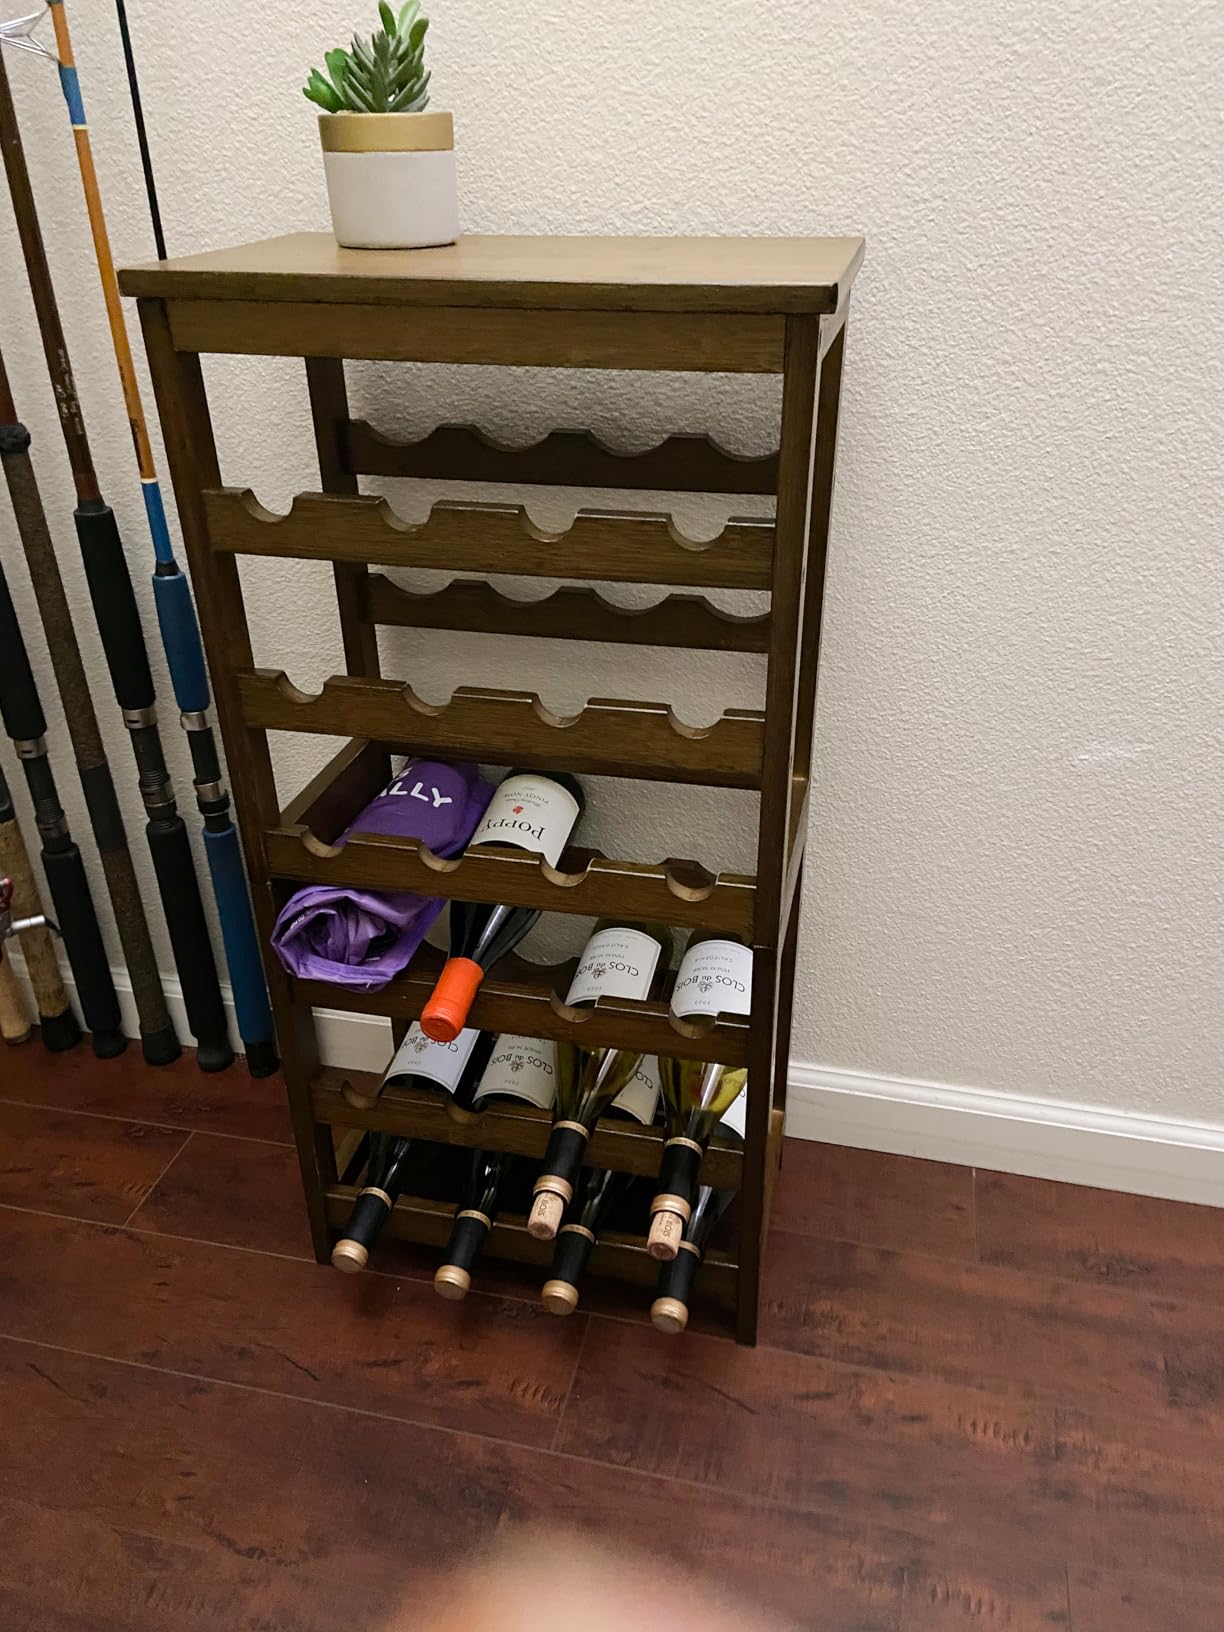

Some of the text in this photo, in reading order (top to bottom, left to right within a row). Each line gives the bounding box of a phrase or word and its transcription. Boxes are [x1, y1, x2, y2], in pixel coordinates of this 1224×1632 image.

[379, 781, 453, 807] LLY
[524, 793, 549, 805] PINOT
[480, 818, 546, 841] POPPY
[595, 962, 606, 970] du
[608, 961, 640, 977] CLOS
[715, 975, 746, 993] CLOS
[526, 1055, 554, 1075] CLOS
[635, 1072, 654, 1089] CLO
